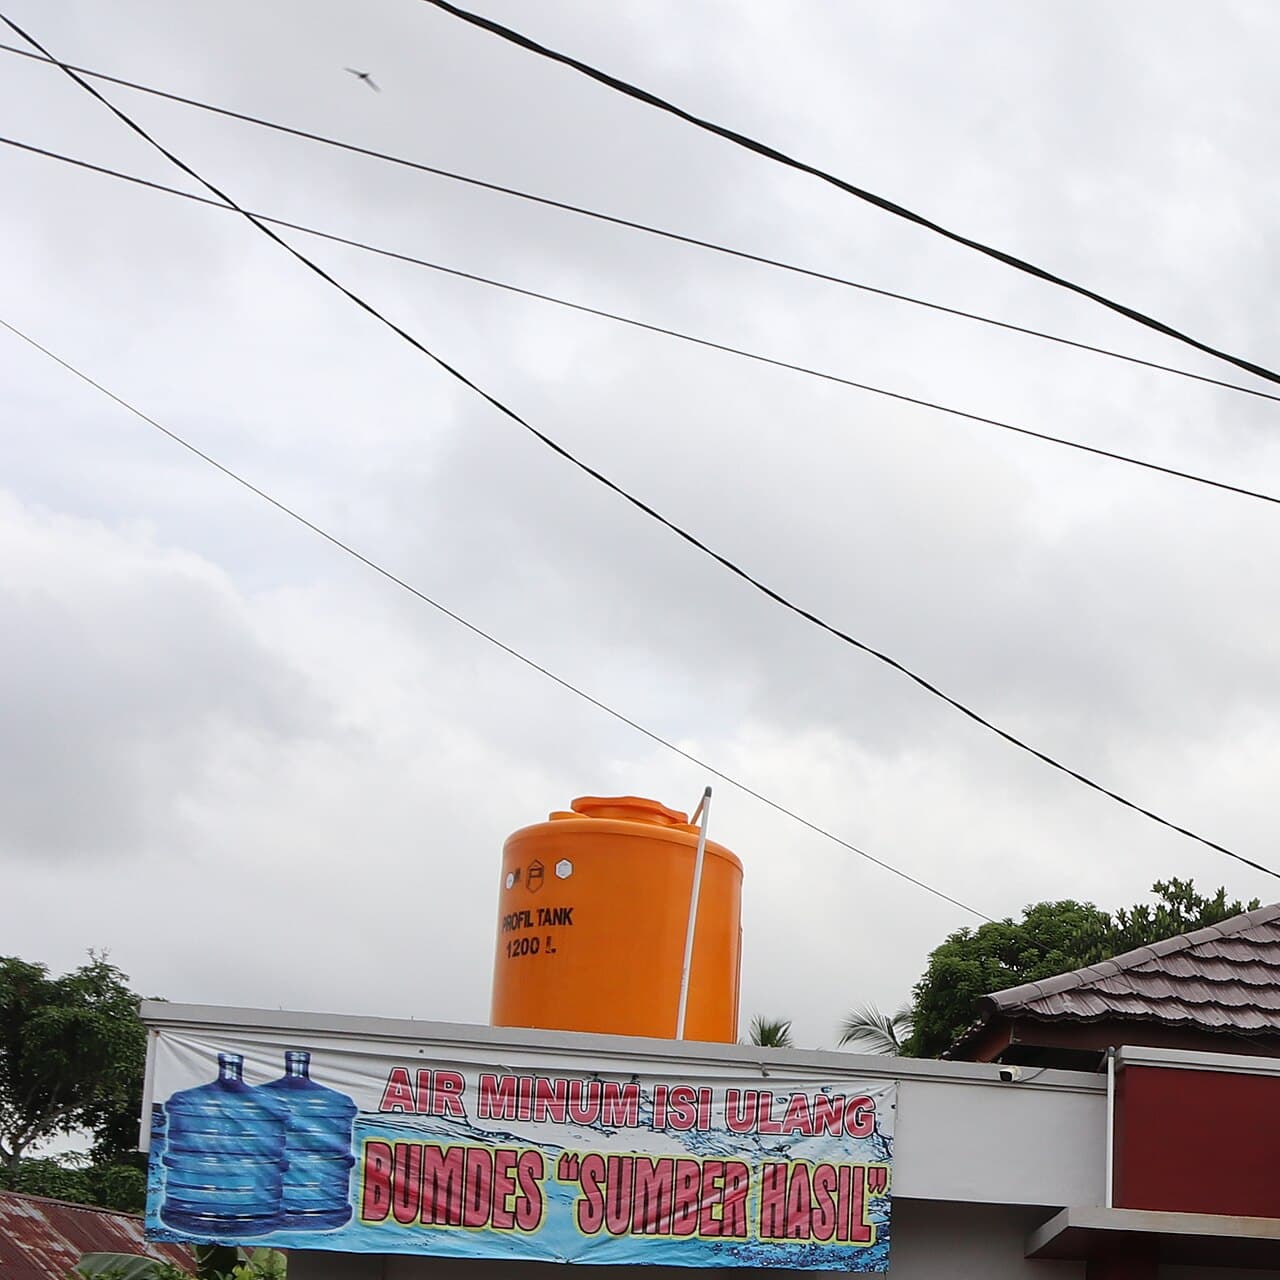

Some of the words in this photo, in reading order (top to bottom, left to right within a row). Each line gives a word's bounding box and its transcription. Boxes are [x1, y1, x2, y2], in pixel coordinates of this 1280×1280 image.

[503, 910, 534, 932] PROFIL
[537, 907, 574, 926] TANK
[507, 937, 540, 958] 1200
[379, 1067, 467, 1117] AIR
[478, 1073, 641, 1128] MINUM
[652, 1084, 713, 1131] ISI
[725, 1089, 877, 1139] ULANG
[361, 1142, 544, 1232] BUMDES
